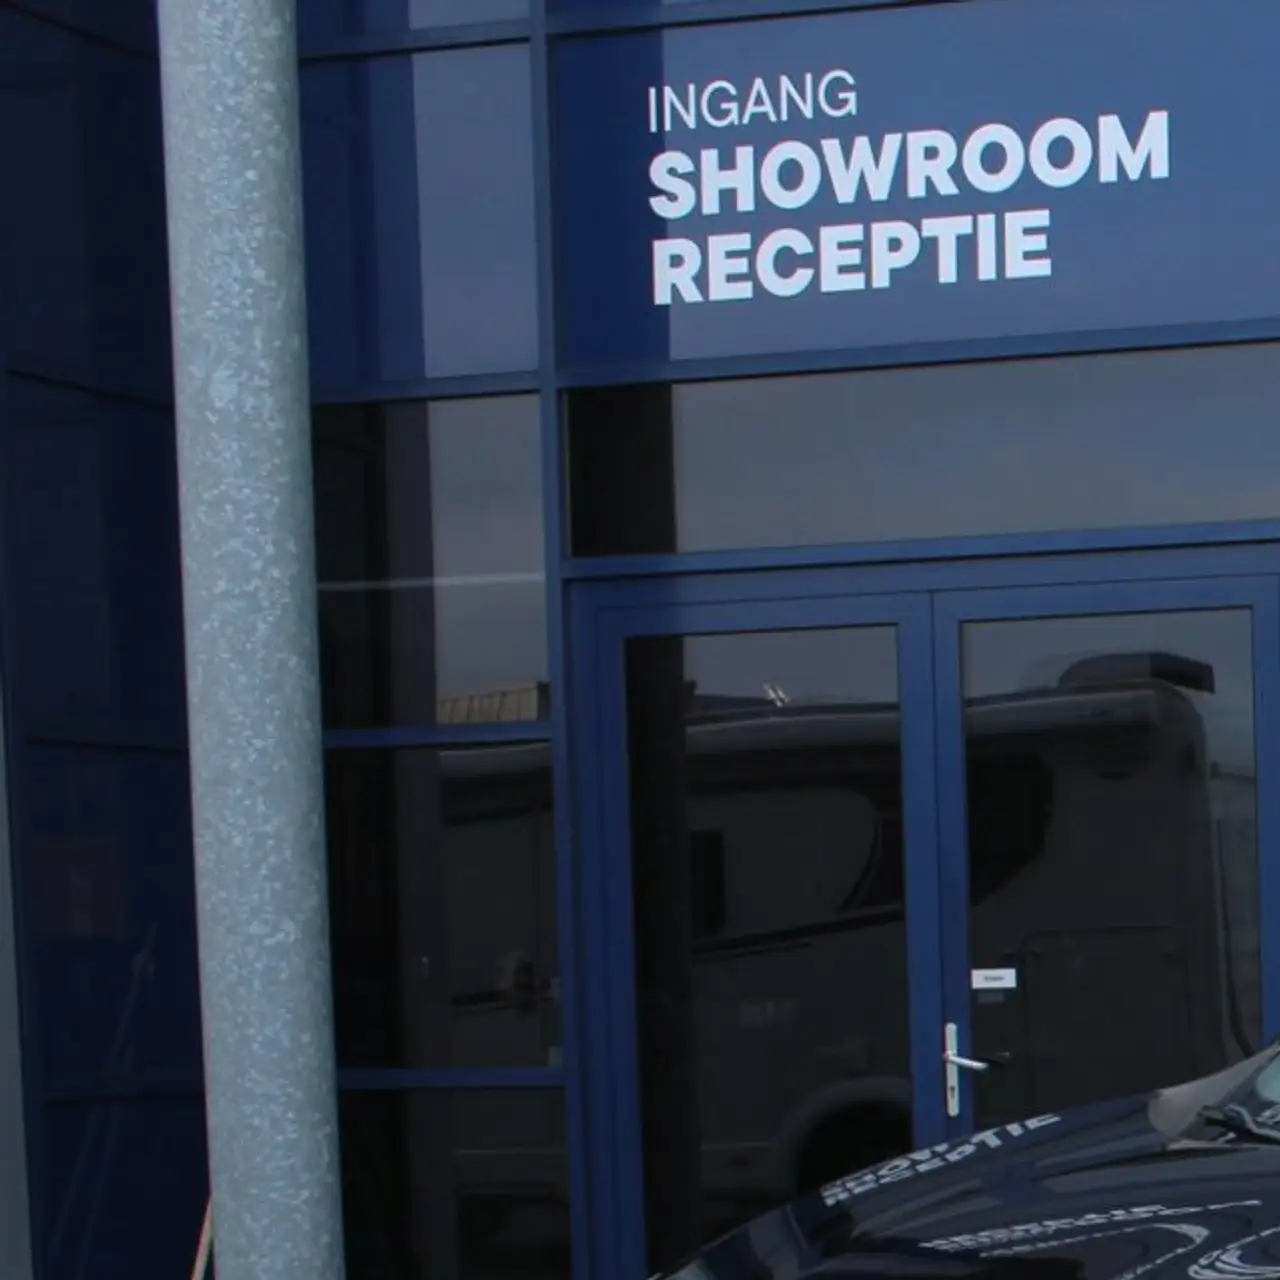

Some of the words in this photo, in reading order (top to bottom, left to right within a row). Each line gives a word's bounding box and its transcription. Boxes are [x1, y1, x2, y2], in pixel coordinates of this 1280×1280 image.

[648, 69, 857, 133] INGANG
[648, 110, 1170, 219] SHOWROOM
[652, 208, 1052, 306] RECEPTIE
